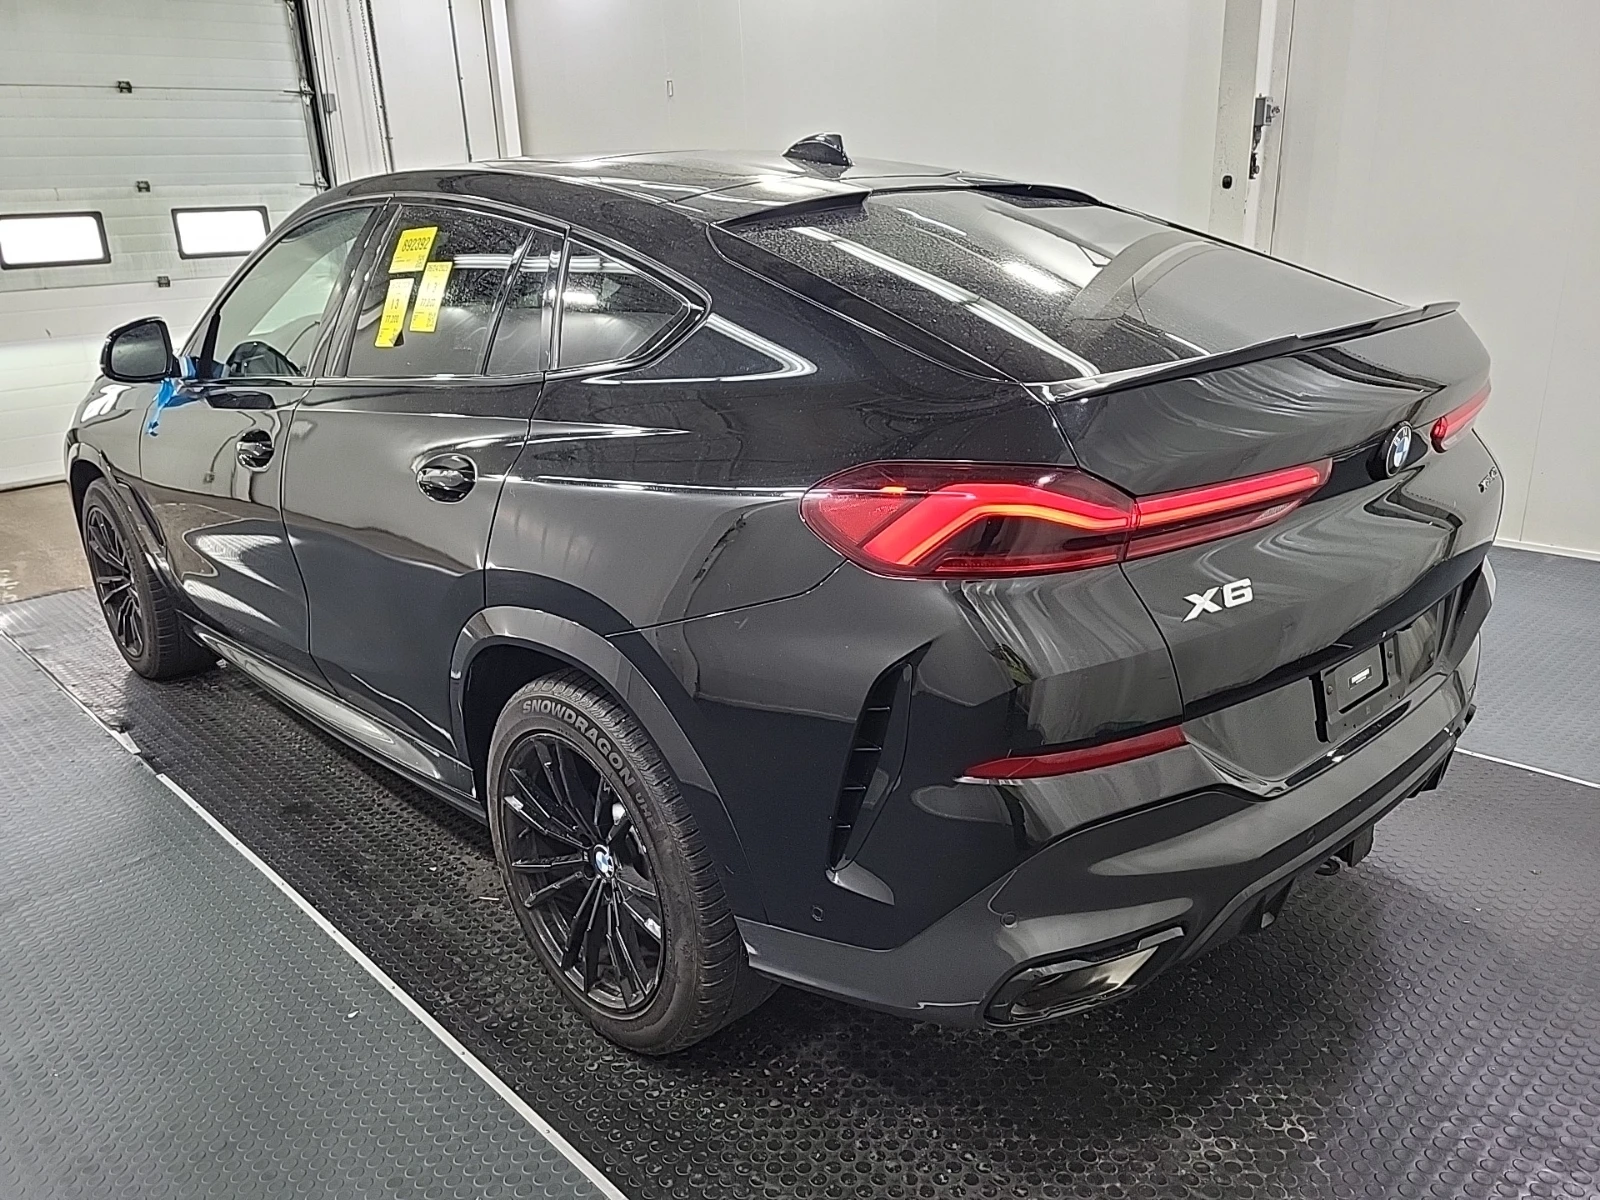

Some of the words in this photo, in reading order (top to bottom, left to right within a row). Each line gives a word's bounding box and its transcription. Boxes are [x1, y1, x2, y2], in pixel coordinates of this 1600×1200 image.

[401, 237, 431, 251] 892392
[1182, 577, 1253, 622] X6
[523, 699, 636, 788] SNOWDRAGON
